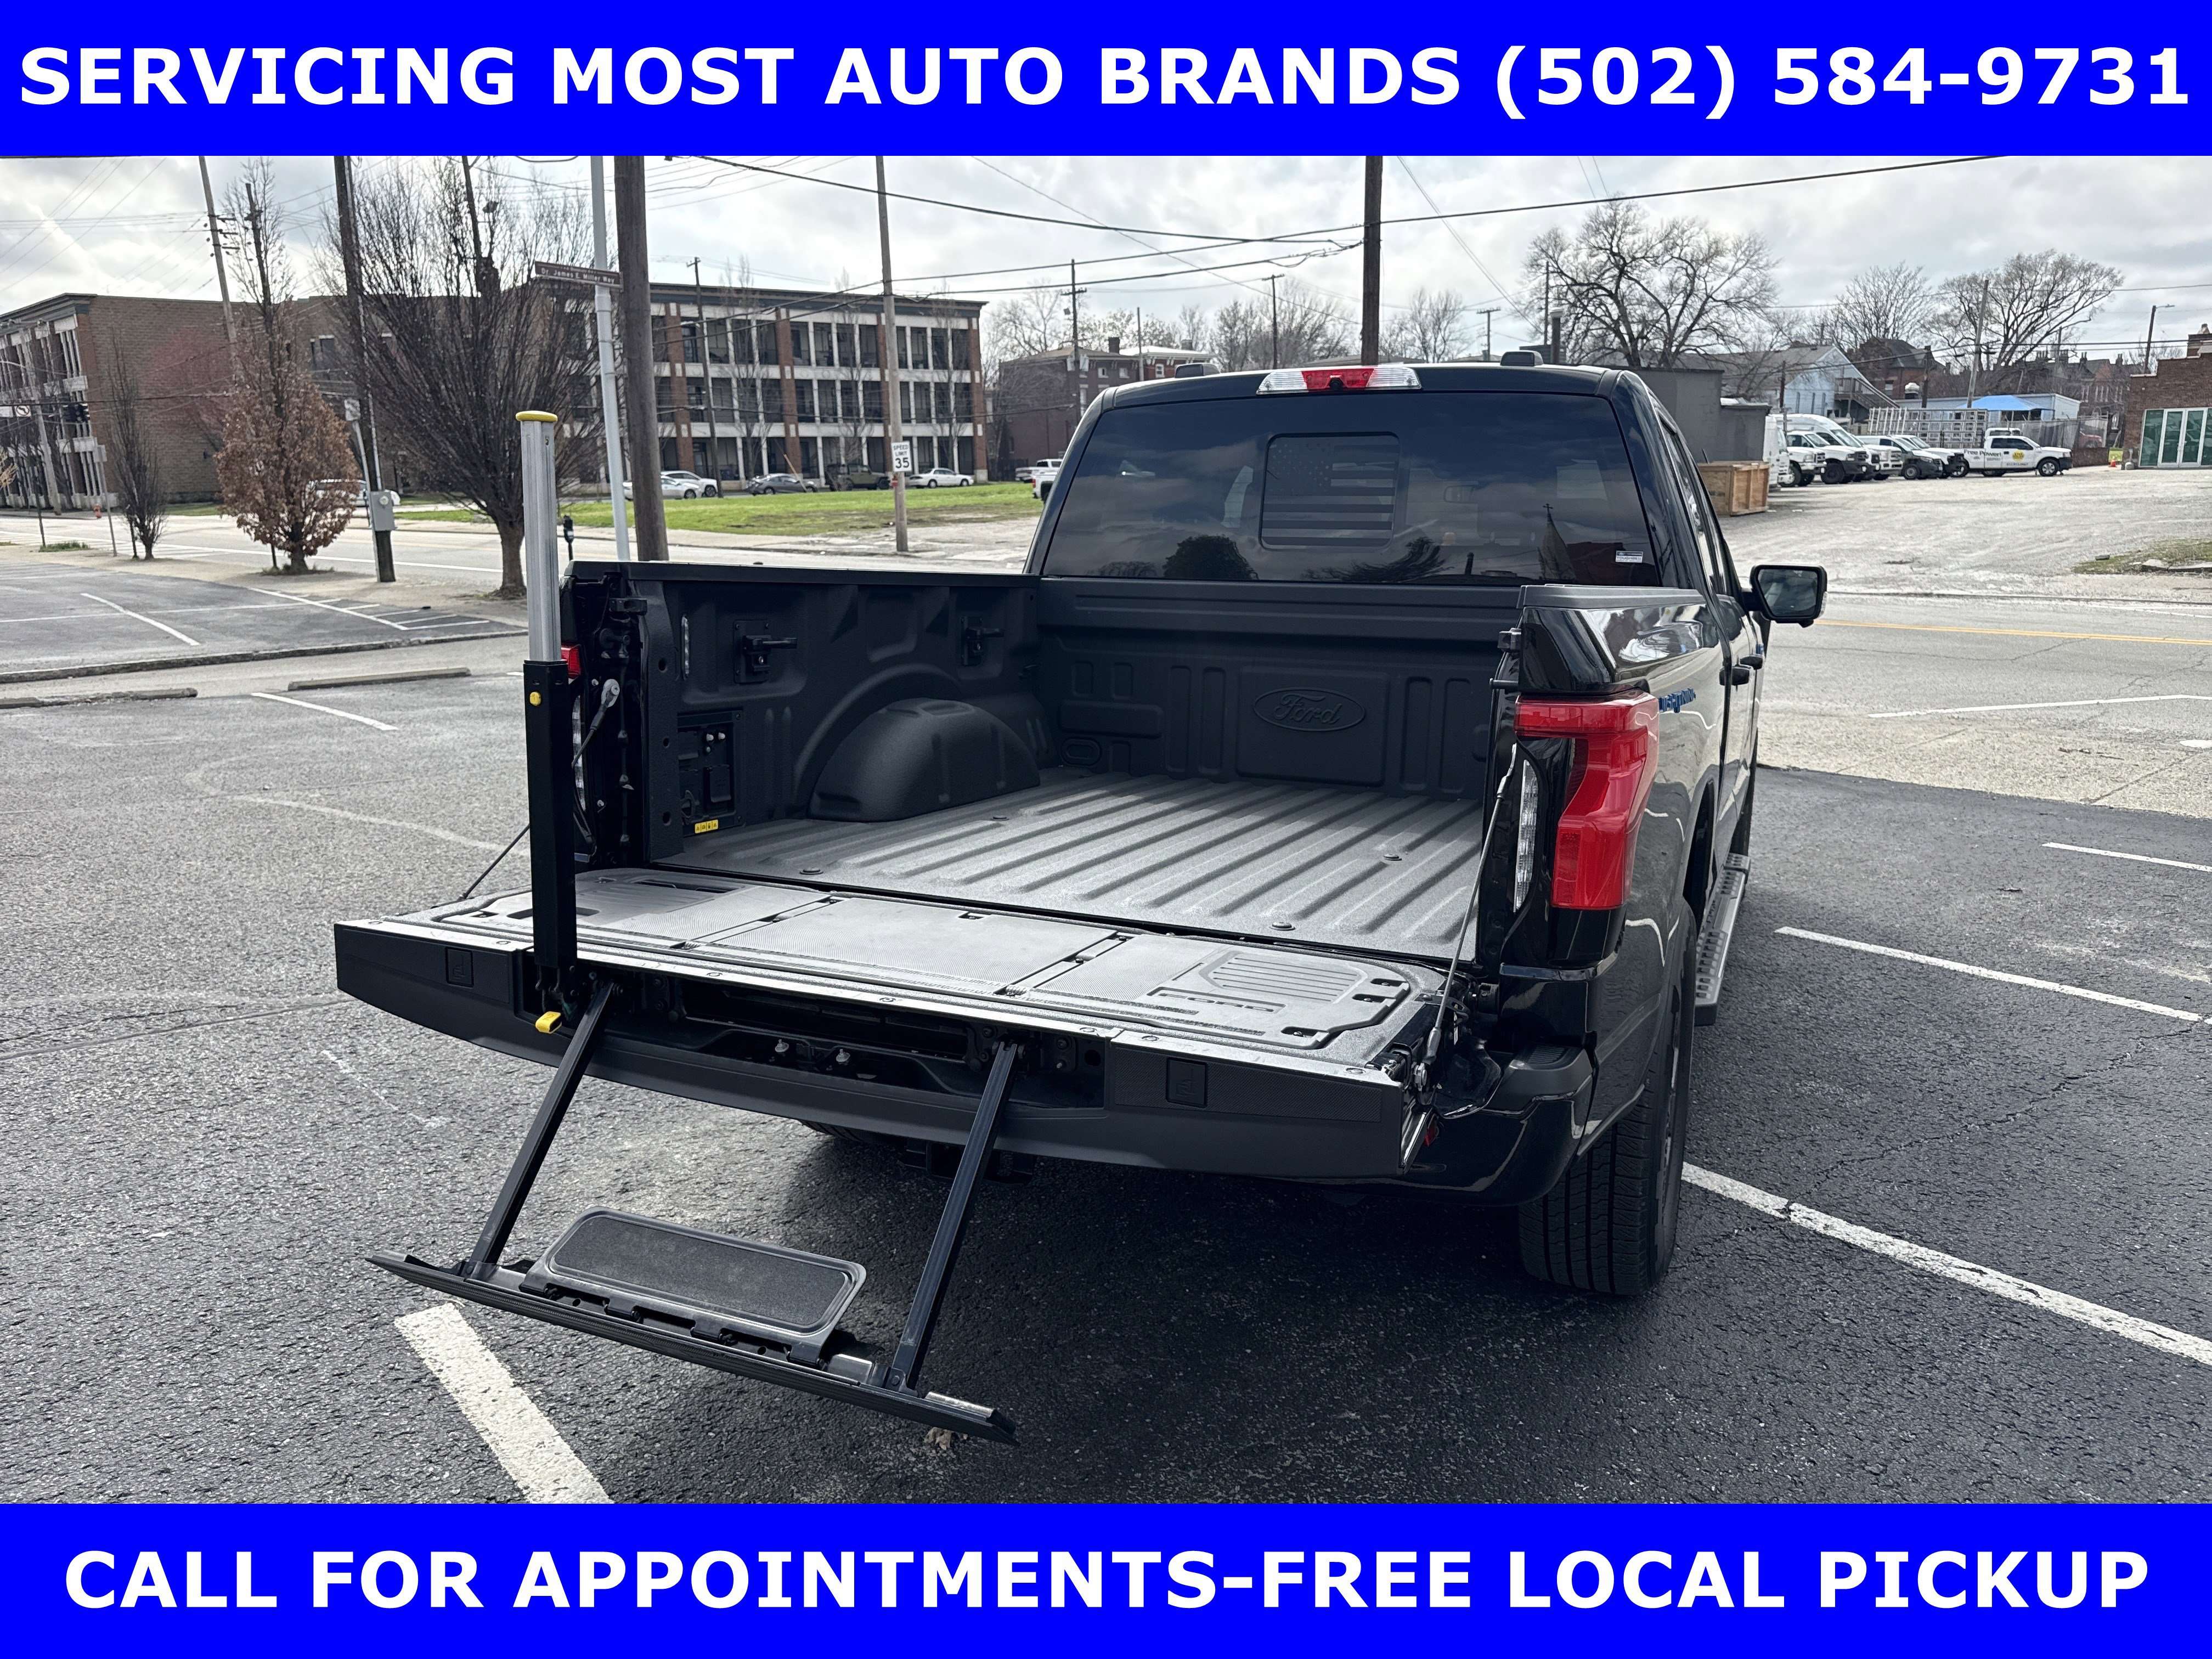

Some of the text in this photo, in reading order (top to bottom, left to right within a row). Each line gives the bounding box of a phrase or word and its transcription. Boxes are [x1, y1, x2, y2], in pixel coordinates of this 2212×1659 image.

[554, 269, 574, 278] James
[602, 276, 614, 284] Way
[895, 457, 909, 469] 35
[1273, 692, 1342, 725] Ford
